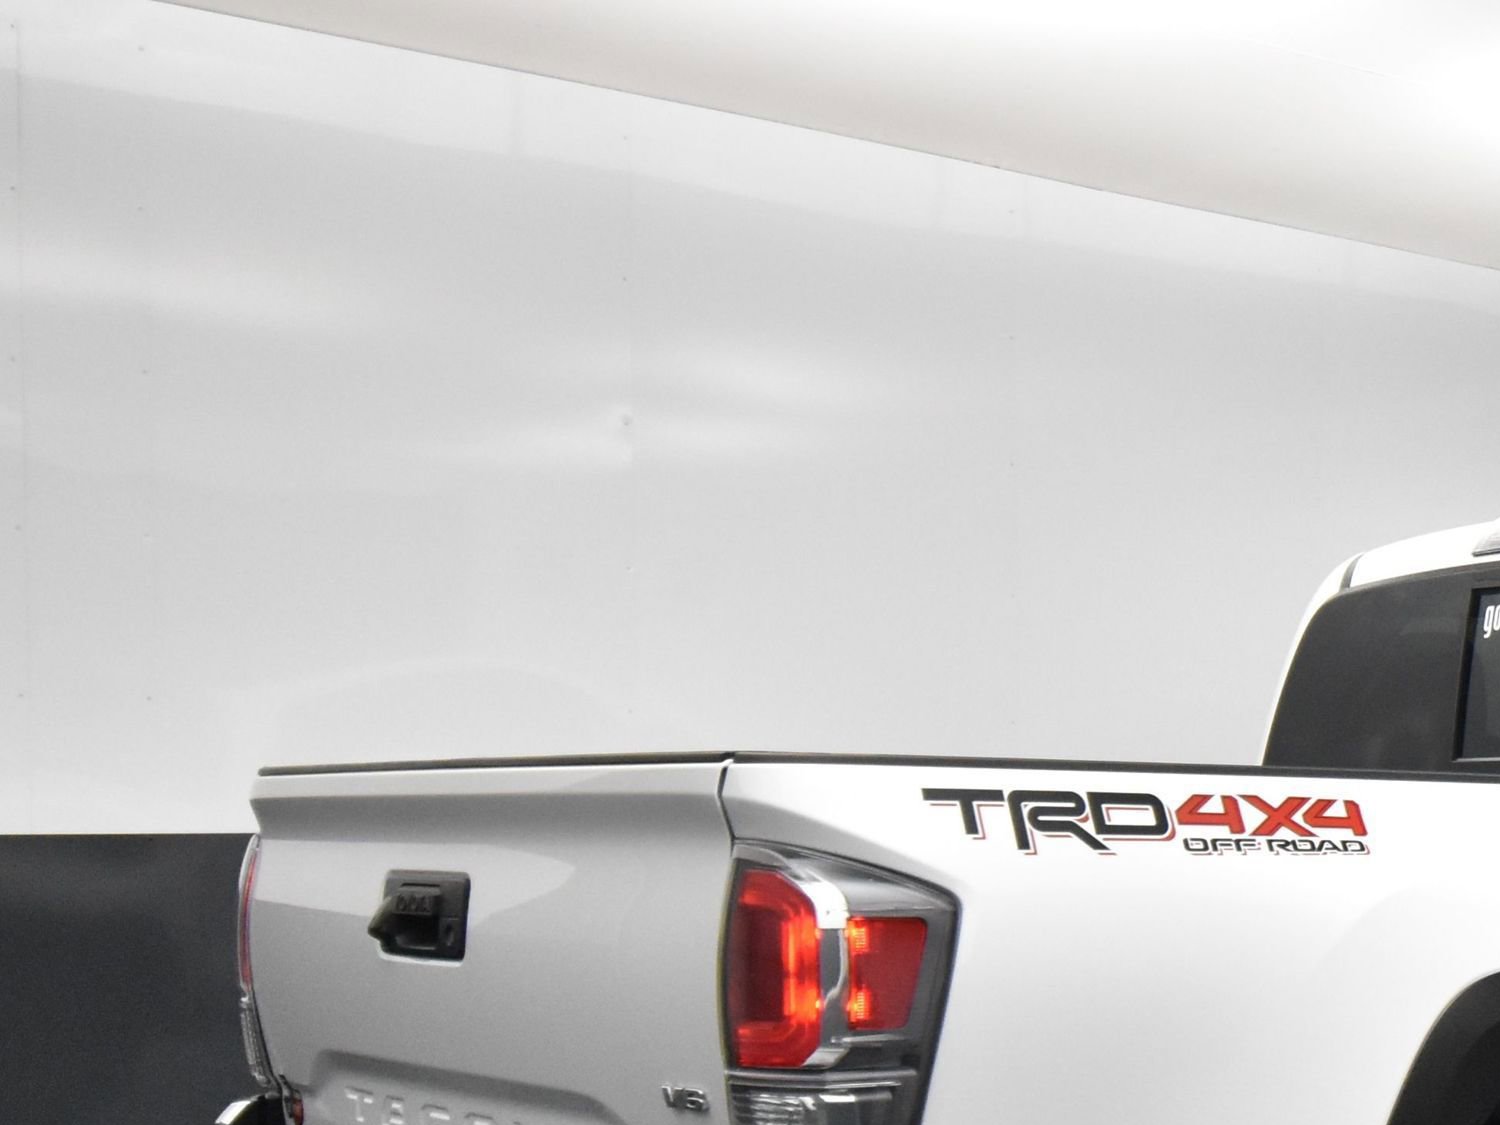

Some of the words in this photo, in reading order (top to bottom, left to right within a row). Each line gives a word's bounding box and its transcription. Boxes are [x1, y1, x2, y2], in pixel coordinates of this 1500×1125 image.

[921, 788, 1174, 855] TRD
[1183, 837, 1259, 854] OFF
[1268, 838, 1369, 855] ROAD
[661, 1081, 711, 1113] V6
